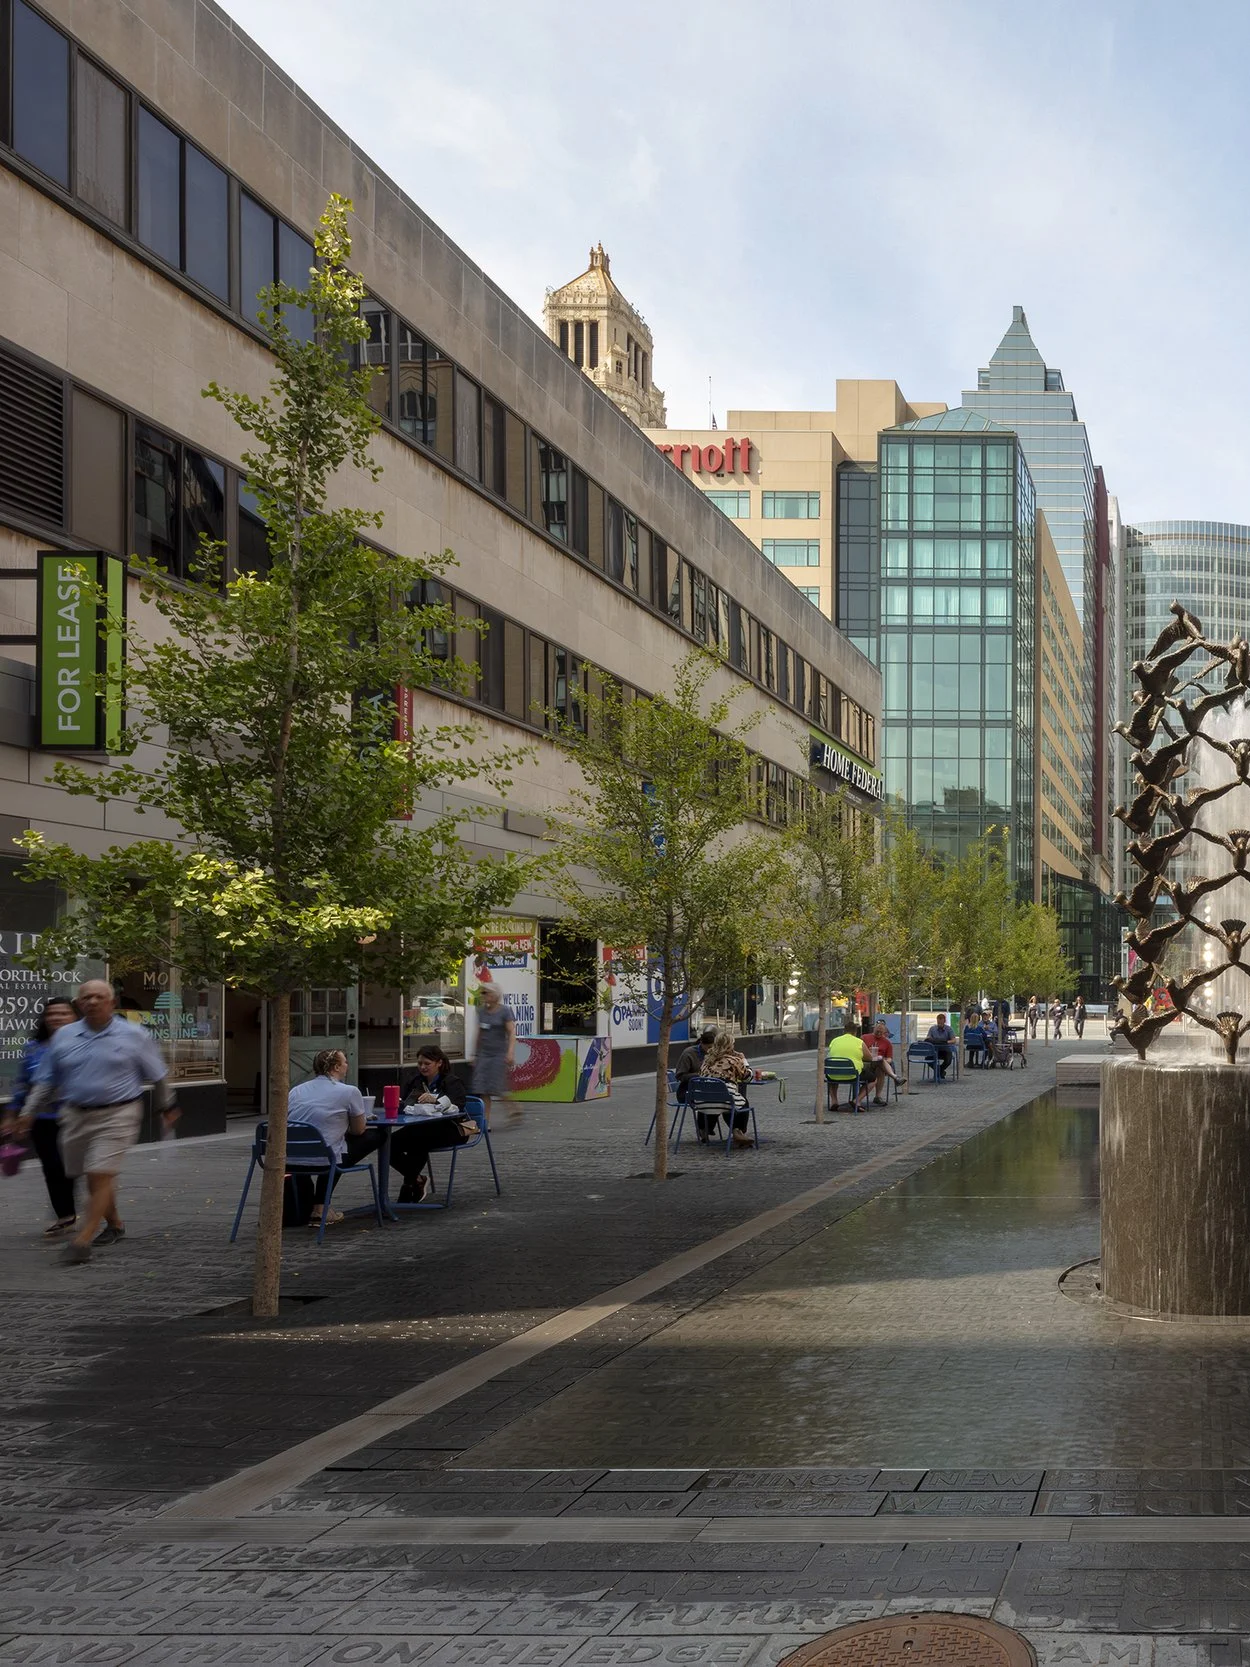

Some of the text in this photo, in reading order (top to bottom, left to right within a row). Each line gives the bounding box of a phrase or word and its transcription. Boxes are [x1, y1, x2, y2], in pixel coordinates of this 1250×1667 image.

[57, 565, 81, 731] FOR LEASE
[823, 743, 851, 781] HOME
[851, 761, 886, 802] FEDERAL
[15, 983, 49, 991] ESTATE
[503, 993, 529, 1005] WE'LL BE
[922, 1473, 1040, 1485] NEW
[879, 1496, 1033, 1510] WERE
[110, 1543, 226, 1565] THE
[222, 1545, 522, 1565] BEGINNING
[914, 1545, 1008, 1563] THE
[311, 1577, 375, 1594] IS
[676, 1576, 991, 1596] PERPETUAL
[174, 1606, 340, 1626] THEY
[353, 1606, 500, 1626] TELL
[507, 1605, 616, 1628] THE
[629, 1604, 874, 1627] FUTURE
[331, 1641, 437, 1664] ON
[446, 1639, 569, 1664] THE
[584, 1642, 752, 1664] EDGE
